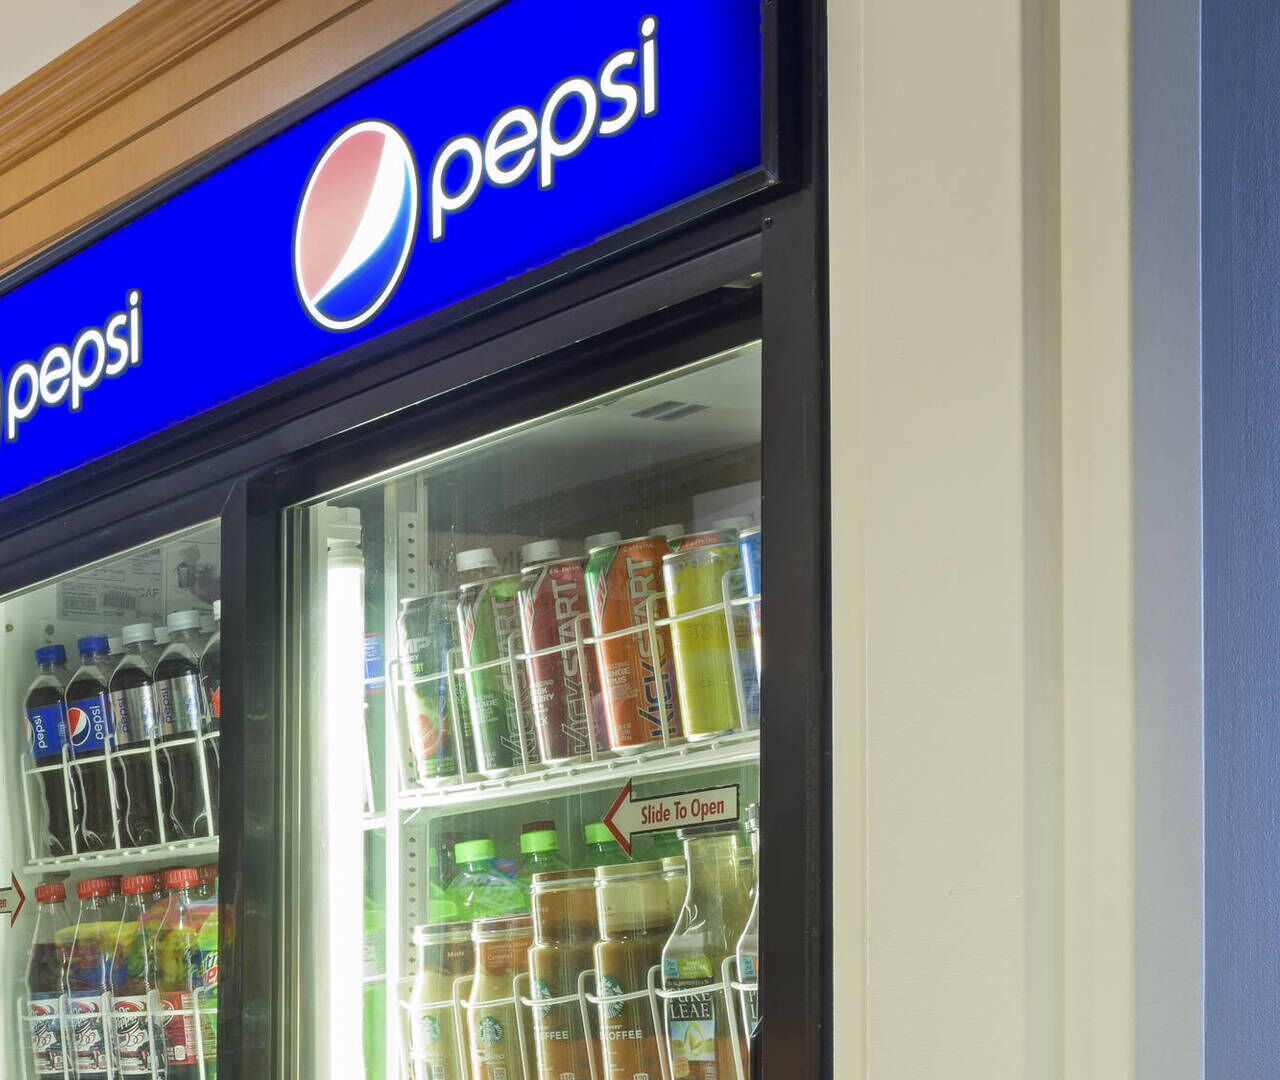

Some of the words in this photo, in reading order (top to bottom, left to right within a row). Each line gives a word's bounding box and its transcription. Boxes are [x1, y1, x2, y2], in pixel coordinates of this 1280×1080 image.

[429, 16, 660, 241] pepsi
[4, 288, 144, 440] pepsi
[34, 714, 48, 749] pepsi
[90, 705, 105, 741] pepsi
[641, 802, 671, 825] Slide
[674, 800, 688, 820] To
[690, 798, 725, 822] Open
[670, 1003, 710, 1020] LEAF
